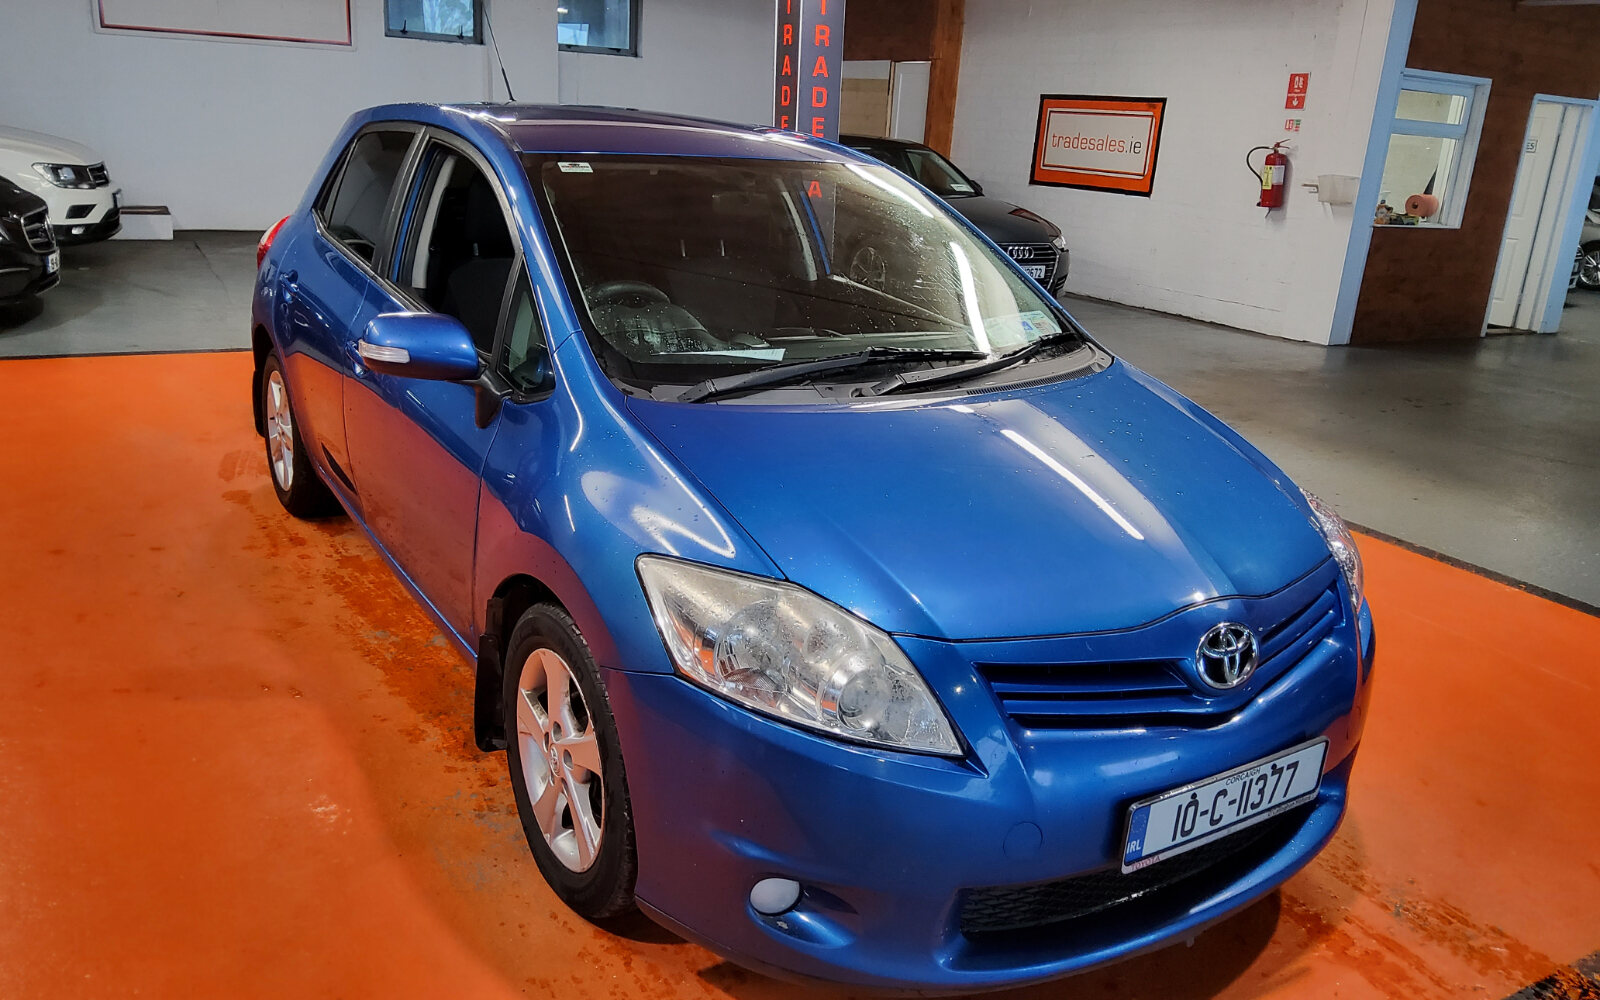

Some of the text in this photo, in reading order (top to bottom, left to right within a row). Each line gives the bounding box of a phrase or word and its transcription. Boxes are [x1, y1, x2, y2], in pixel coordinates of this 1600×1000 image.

[811, 0, 831, 138] TRADE
[1051, 131, 1142, 155] tradesales.ie
[1024, 268, 1043, 277] 672
[1225, 767, 1261, 786] CORCAIGH
[1171, 760, 1300, 842] 10-C-11377
[1126, 838, 1142, 854] IRL
